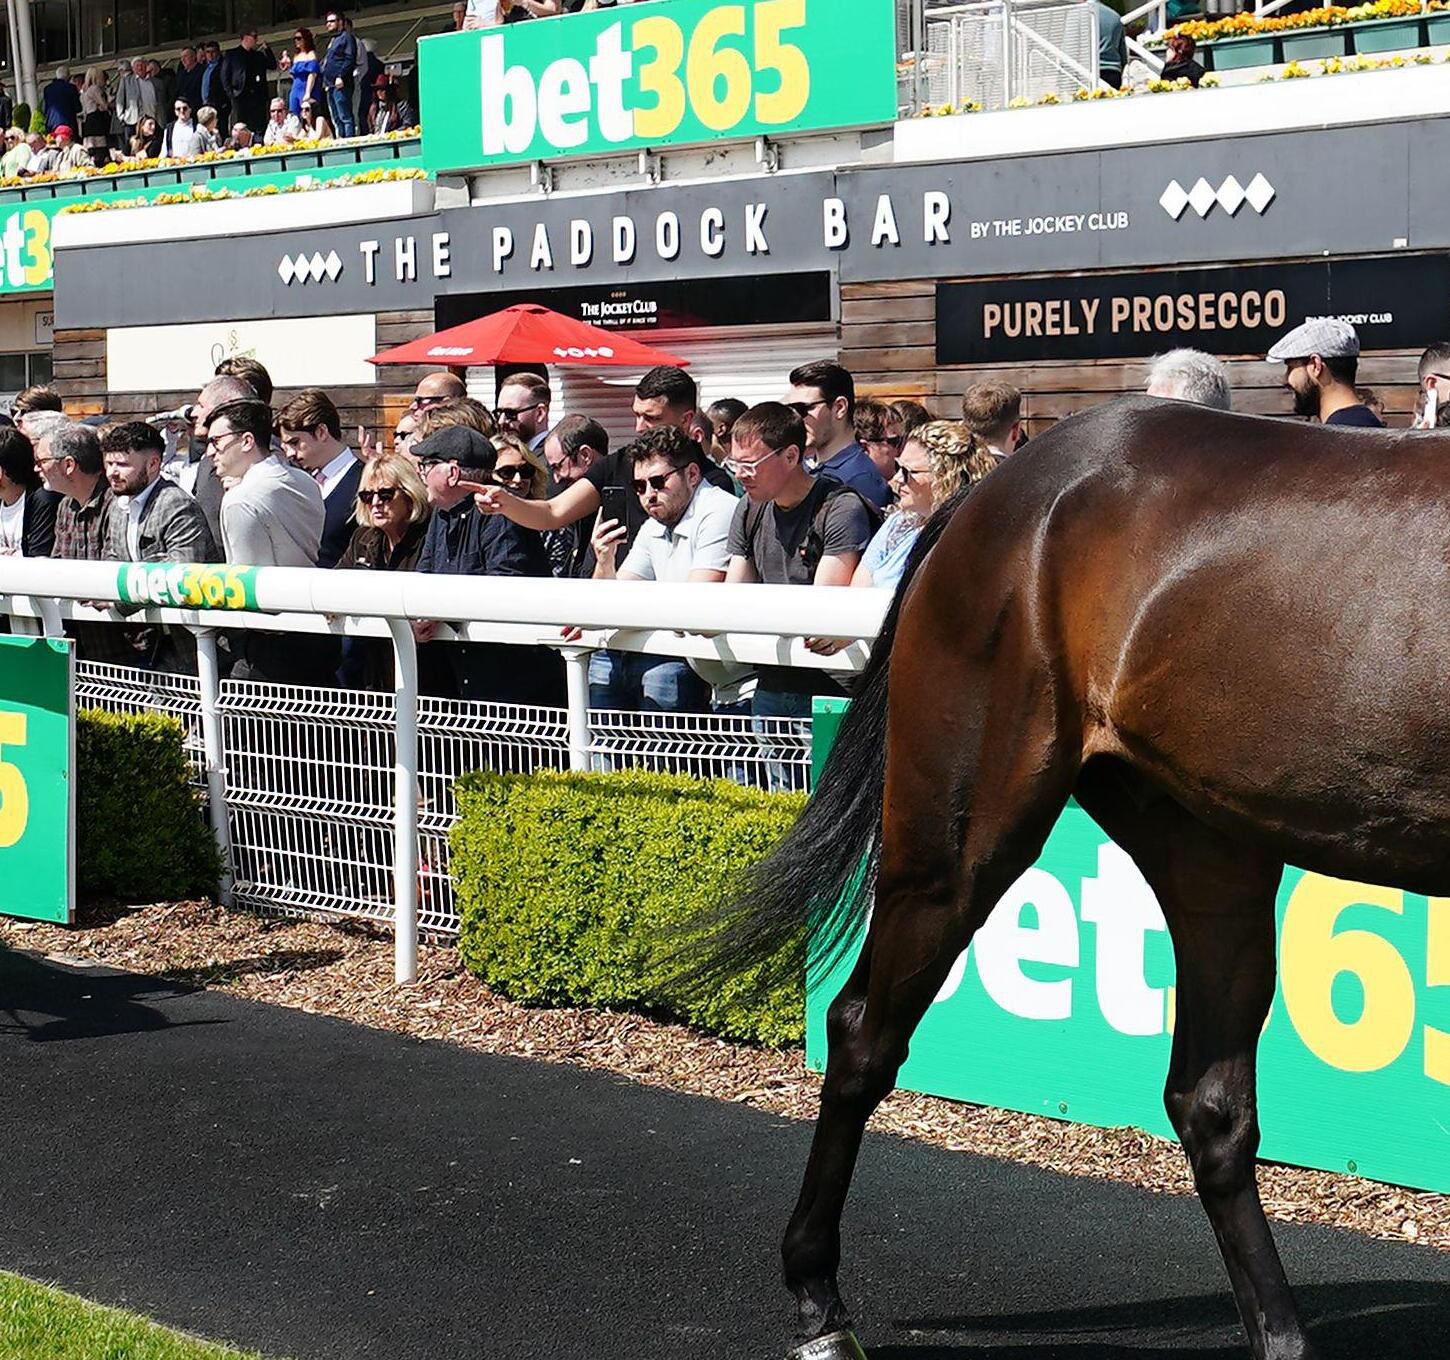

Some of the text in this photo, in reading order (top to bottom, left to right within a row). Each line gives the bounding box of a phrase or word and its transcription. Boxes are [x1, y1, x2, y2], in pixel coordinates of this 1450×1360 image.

[481, 2, 810, 155] bet365
[360, 191, 1129, 283] THE PADDOCK BAR BY THE JOCKEY CLUB
[581, 299, 657, 318] THE JOCKEY CLUB
[984, 289, 1286, 338] PURELY PROSECCO
[1369, 312, 1393, 324] CLUB
